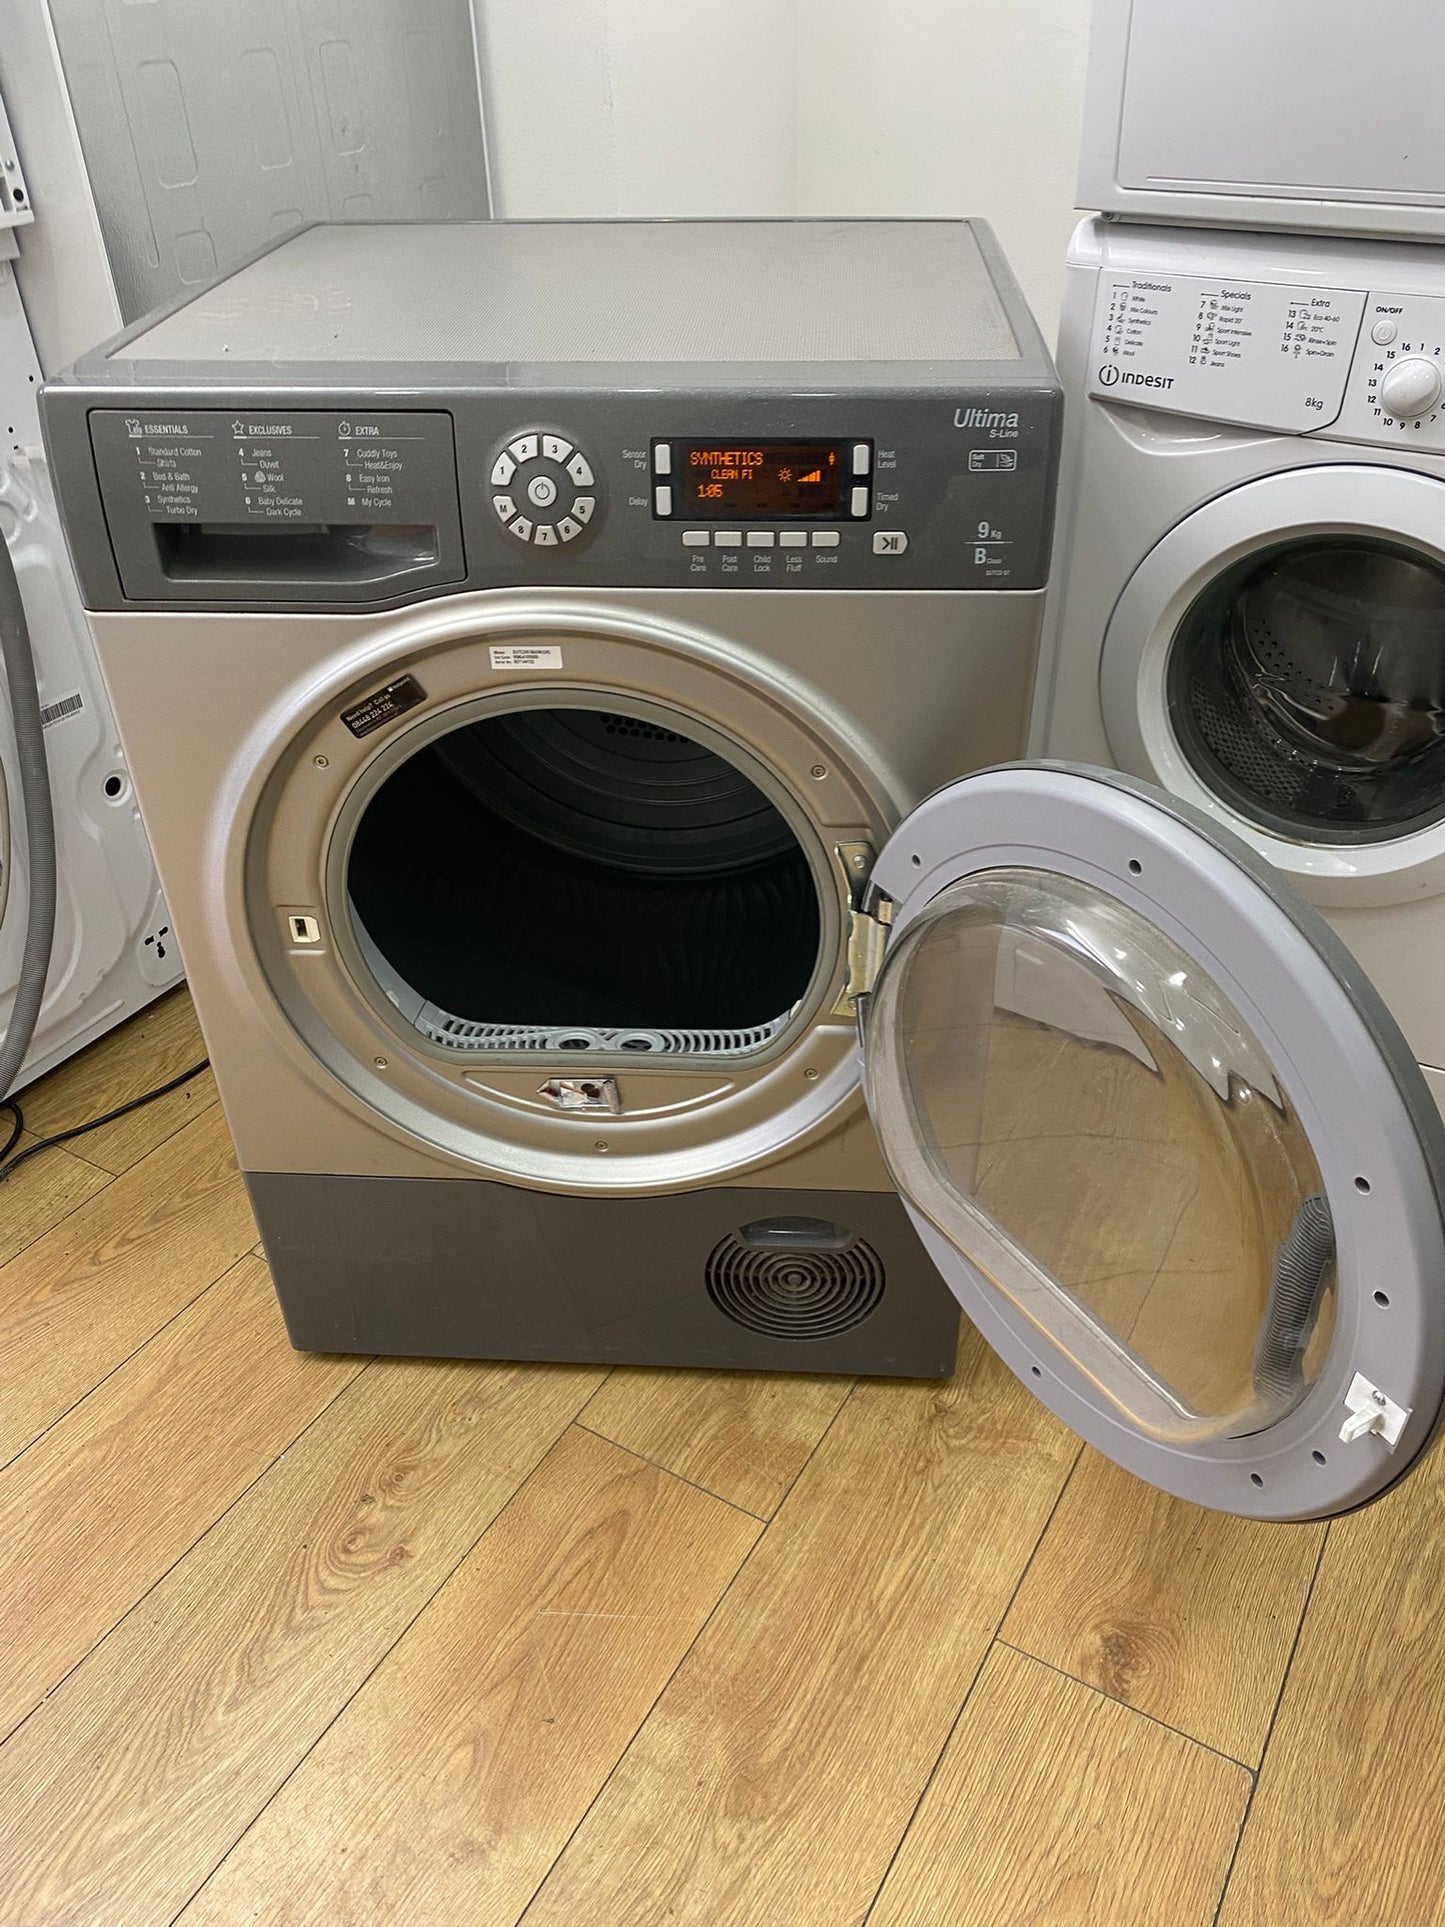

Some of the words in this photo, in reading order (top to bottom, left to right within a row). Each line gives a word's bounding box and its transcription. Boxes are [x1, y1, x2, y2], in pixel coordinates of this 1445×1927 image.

[1132, 281, 1172, 292] Traditionals
[1220, 290, 1251, 300] Specials
[1110, 303, 1116, 311] 2
[1311, 299, 1330, 307] Extra
[1288, 310, 1297, 318] 13
[1375, 306, 1403, 314] ON/OFF
[1198, 312, 1203, 320] 8
[1286, 321, 1294, 330] 14
[1105, 335, 1110, 343] 5
[1193, 334, 1201, 342] 10
[1284, 333, 1292, 341] 15
[1191, 345, 1198, 353] 11
[1281, 344, 1289, 352] 16
[1401, 343, 1411, 351] 16
[1420, 343, 1424, 351] 1
[1434, 347, 1440, 355] 2
[1386, 351, 1396, 359] 15
[1189, 356, 1197, 364] 12
[1374, 363, 1384, 371] 14
[1368, 379, 1377, 387] 13
[1367, 395, 1377, 403] 12
[1305, 397, 1324, 411] 8kg
[1374, 408, 1381, 416] 11
[953, 408, 1019, 428] Ultima
[1383, 418, 1393, 426] 10
[1430, 415, 1437, 423] 7
[144, 425, 188, 434] ESSENTIALS
[1399, 422, 1405, 430] 9
[1414, 421, 1421, 429] 8
[249, 425, 293, 435] EXCLUSIVES
[355, 426, 380, 436] EXTRA
[989, 429, 1019, 438] S-Line
[136, 447, 140, 455] 1
[148, 447, 178, 456] Standard
[180, 448, 202, 456] Cotton
[238, 448, 244, 457] 4
[252, 449, 272, 457] Jeans
[343, 449, 349, 457] 7
[357, 449, 381, 459] Cuddly
[382, 449, 398, 459] Toys
[521, 445, 527, 454] 2
[552, 445, 558, 454] 3
[622, 449, 647, 459] Sensor
[878, 449, 895, 459] Heat
[690, 451, 763, 466] SYNTHETICS
[259, 460, 279, 469] Duvet
[364, 461, 403, 471] Heat&Enjoy
[634, 460, 647, 471] Dry
[877, 460, 896, 469] Level
[500, 466, 504, 475] 1
[576, 467, 582, 475] 4
[710, 469, 738, 479] CLEAN
[741, 469, 753, 479] FI
[140, 472, 145, 480] 2
[153, 472, 167, 481] Bed
[168, 473, 173, 481] &
[174, 473, 190, 481] Bath
[266, 473, 284, 481] Wool
[345, 474, 352, 482] 8
[359, 474, 376, 484] Easy
[376, 474, 390, 482] Iron
[162, 483, 175, 492] Anti
[176, 483, 199, 493] Allergy
[263, 484, 276, 493] Silk
[367, 485, 393, 494] Refresh
[145, 495, 150, 504] 3
[157, 495, 191, 505] Synthetics
[245, 496, 251, 504] 6
[258, 497, 275, 506] Baby
[276, 497, 303, 505] Delicate
[877, 492, 899, 501] Timed
[361, 498, 372, 508] My
[373, 498, 392, 508] Cycle
[628, 497, 649, 507] Delay
[166, 506, 185, 515] Turbo
[186, 506, 198, 516] Dry
[500, 505, 508, 513] M
[579, 506, 585, 514] 5
[876, 502, 889, 512] Dry
[266, 507, 282, 516] Dark
[283, 508, 302, 517] Cycle
[518, 526, 524, 534] 8
[564, 526, 570, 534] 6
[977, 521, 990, 539] 9
[990, 529, 1002, 540] Kg
[542, 533, 548, 541] 7
[692, 555, 705, 563] Pre
[722, 555, 738, 563] Post
[753, 555, 772, 563] Child
[786, 555, 802, 563] Less
[815, 555, 838, 563] Sound
[974, 547, 987, 565] B
[690, 564, 707, 572] Care
[722, 564, 738, 572] Care
[753, 564, 771, 573] Lock
[786, 564, 803, 573] Fluff
[370, 708, 383, 719] 224
[380, 701, 394, 712] 224
[346, 711, 361, 722] Need
